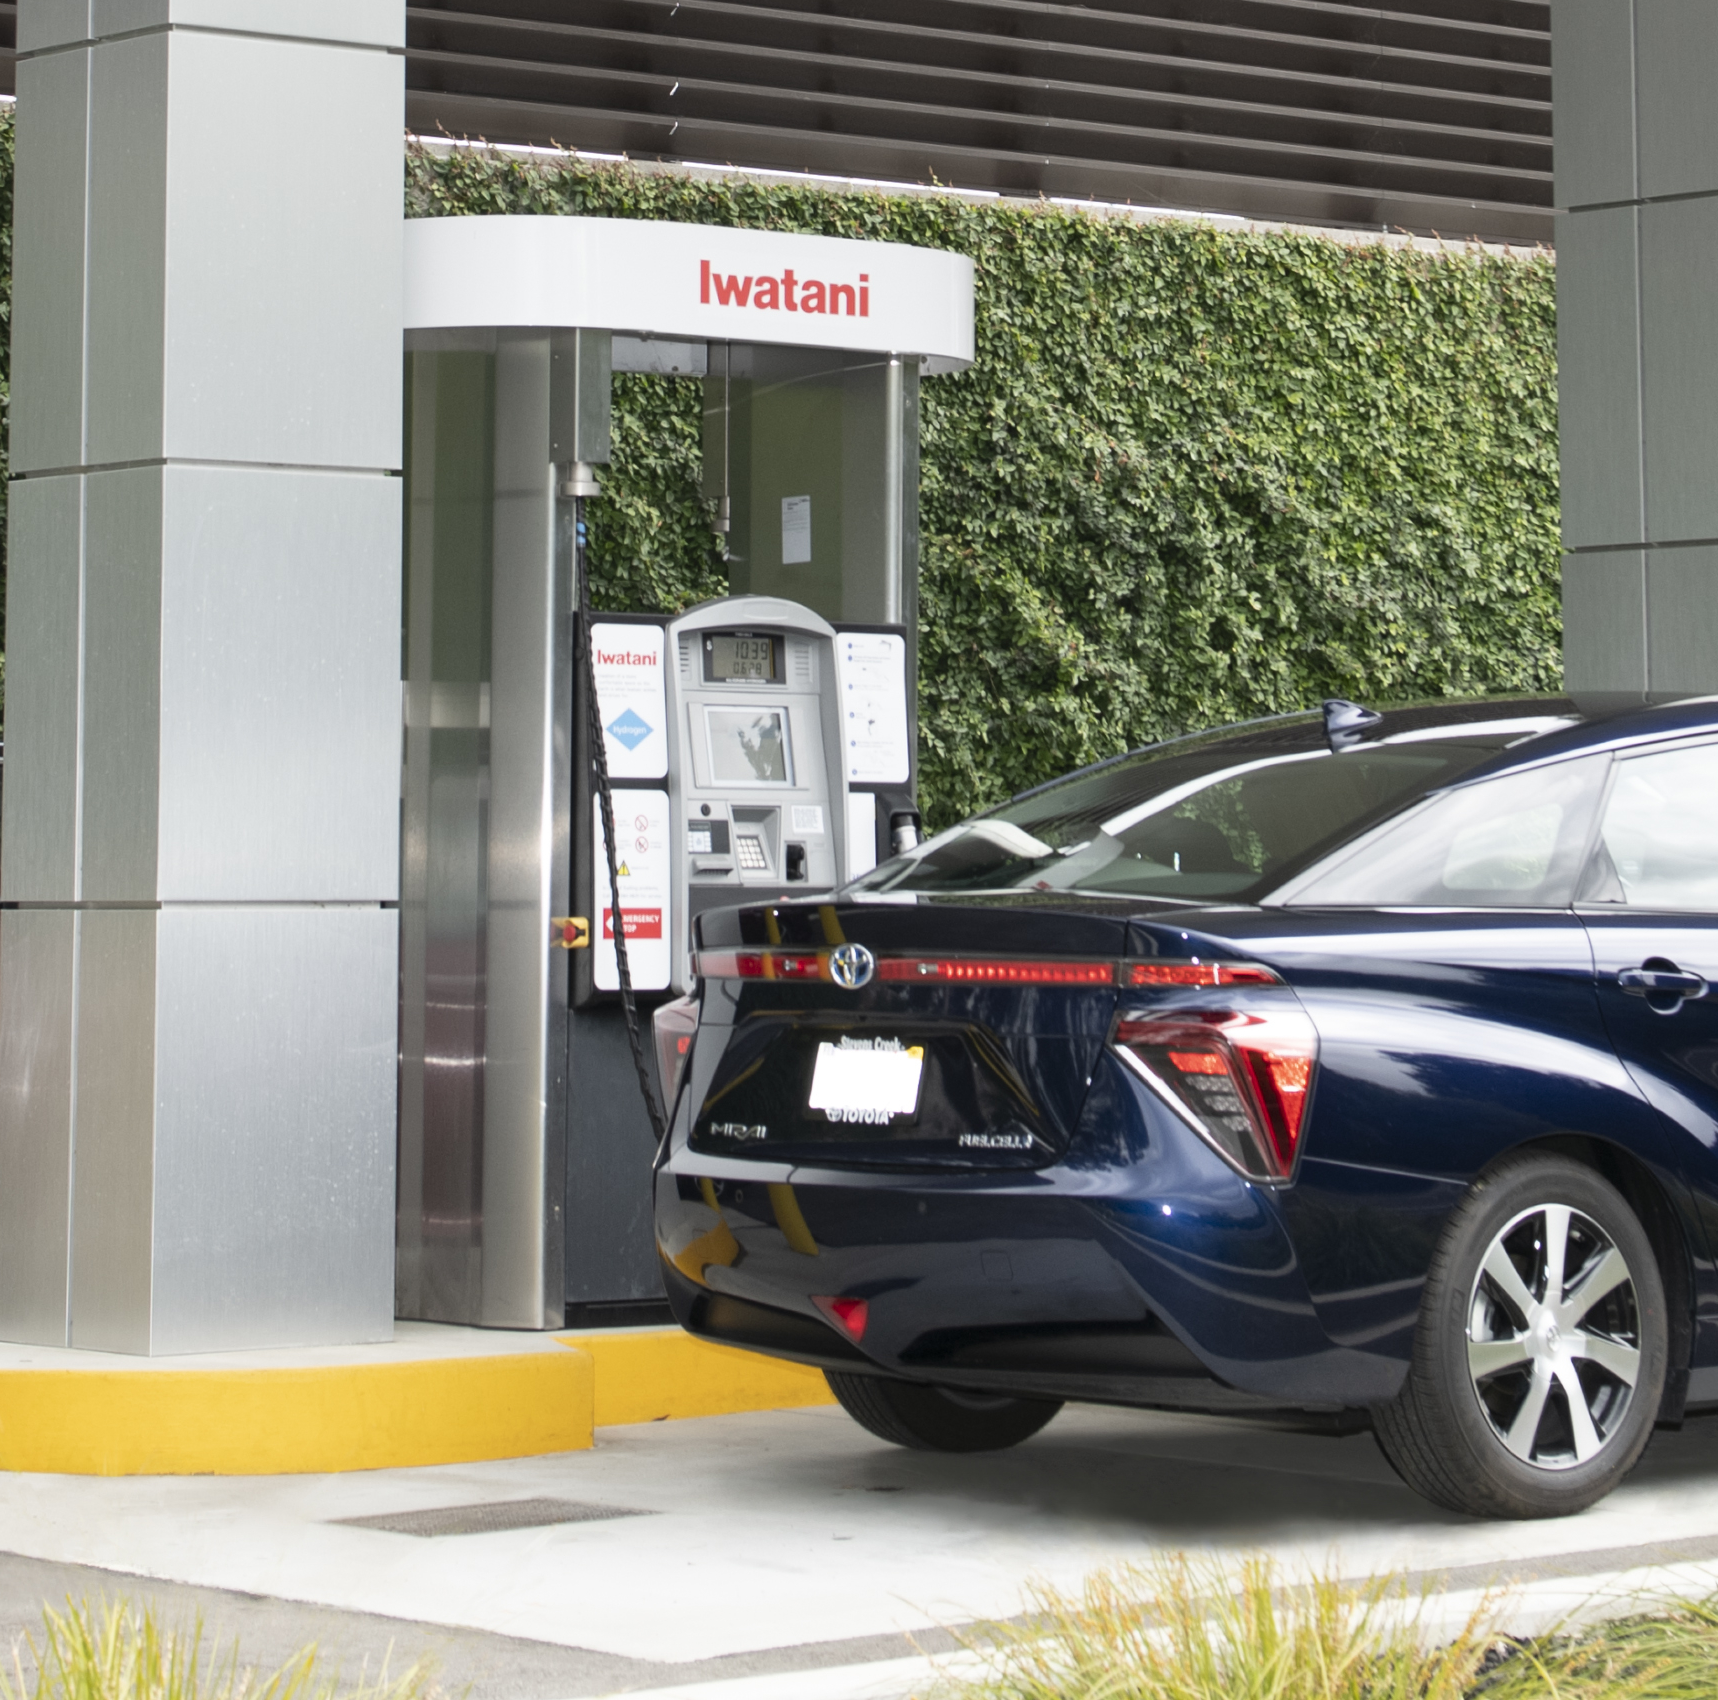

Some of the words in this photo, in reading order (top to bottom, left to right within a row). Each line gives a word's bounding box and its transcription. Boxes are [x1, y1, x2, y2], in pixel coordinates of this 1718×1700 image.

[700, 259, 869, 317] Iwatani
[597, 649, 657, 666] Iwatani
[612, 725, 647, 737] Hydrogen
[622, 914, 660, 923] MERGENCY
[623, 924, 637, 933] TOP
[842, 1108, 889, 1125] TOYOTA
[710, 1121, 767, 1141] MIRAI
